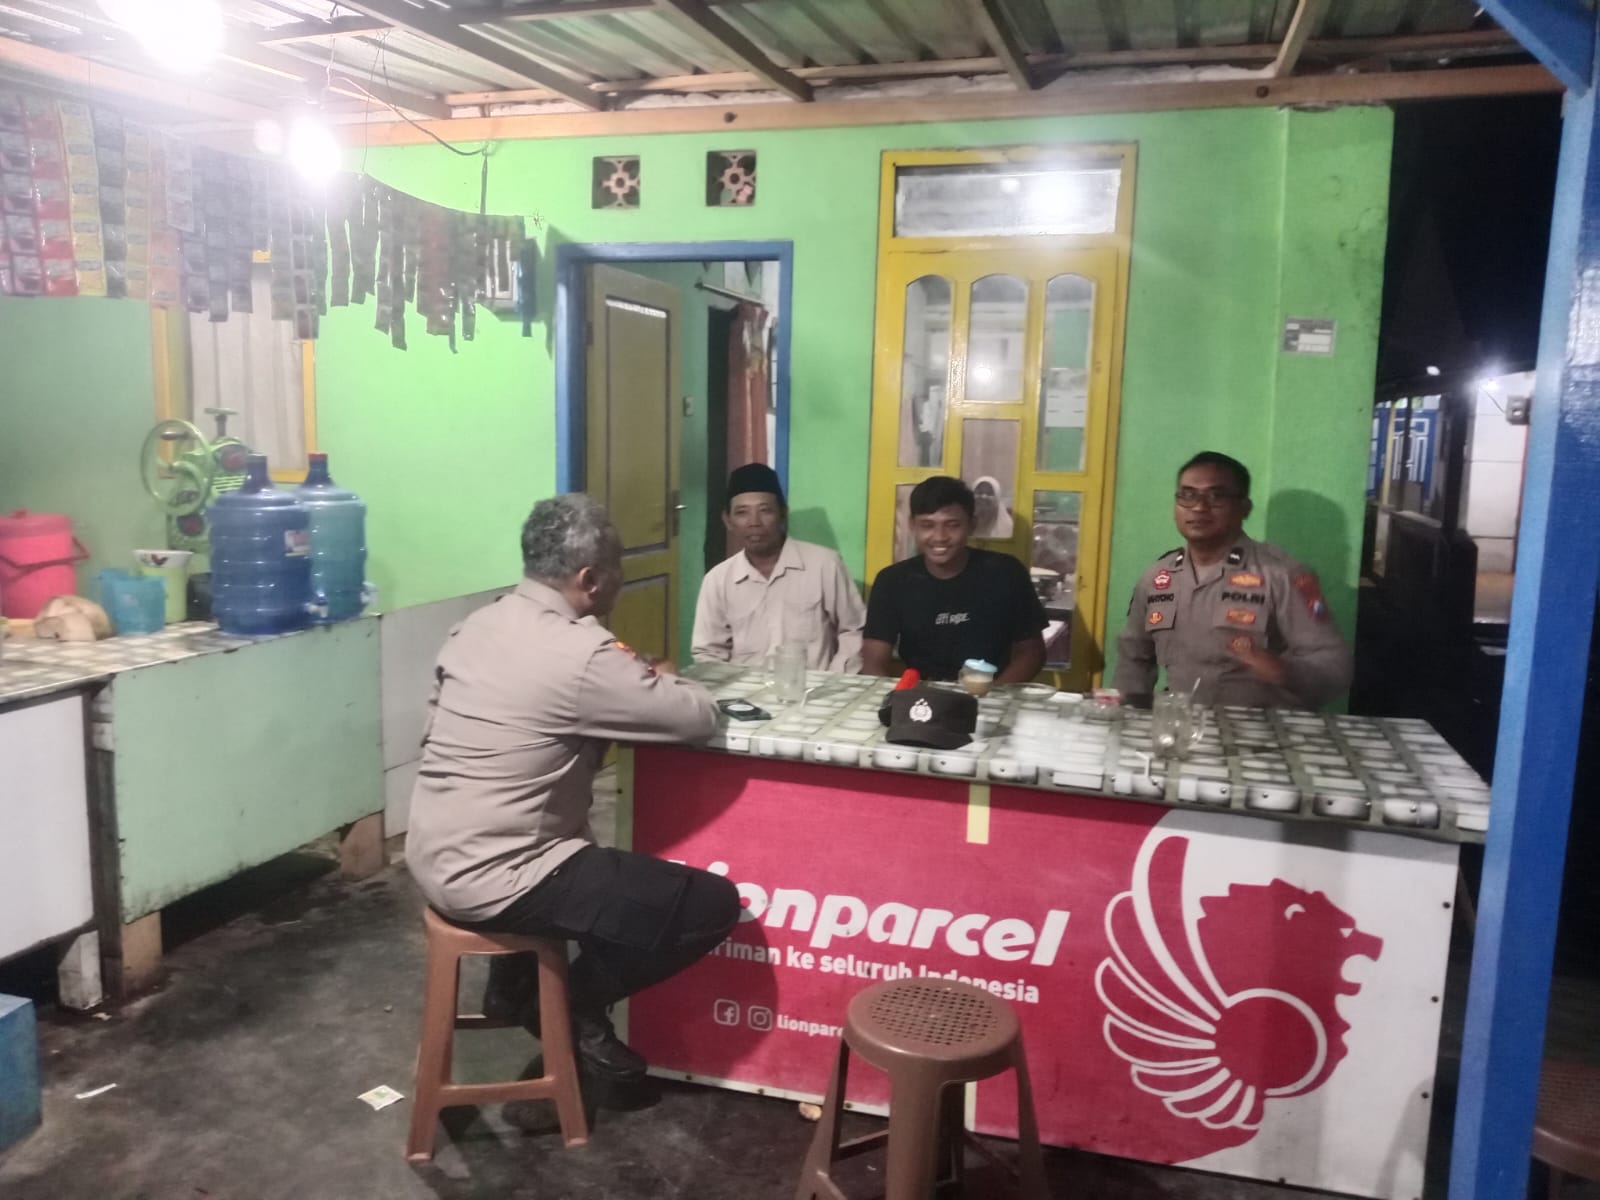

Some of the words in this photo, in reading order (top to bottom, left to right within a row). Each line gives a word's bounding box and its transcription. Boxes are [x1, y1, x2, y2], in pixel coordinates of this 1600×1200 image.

[667, 859, 1071, 967] onparcel
[708, 936, 781, 966] riman
[786, 945, 815, 970] ke
[819, 954, 912, 981] seluruh
